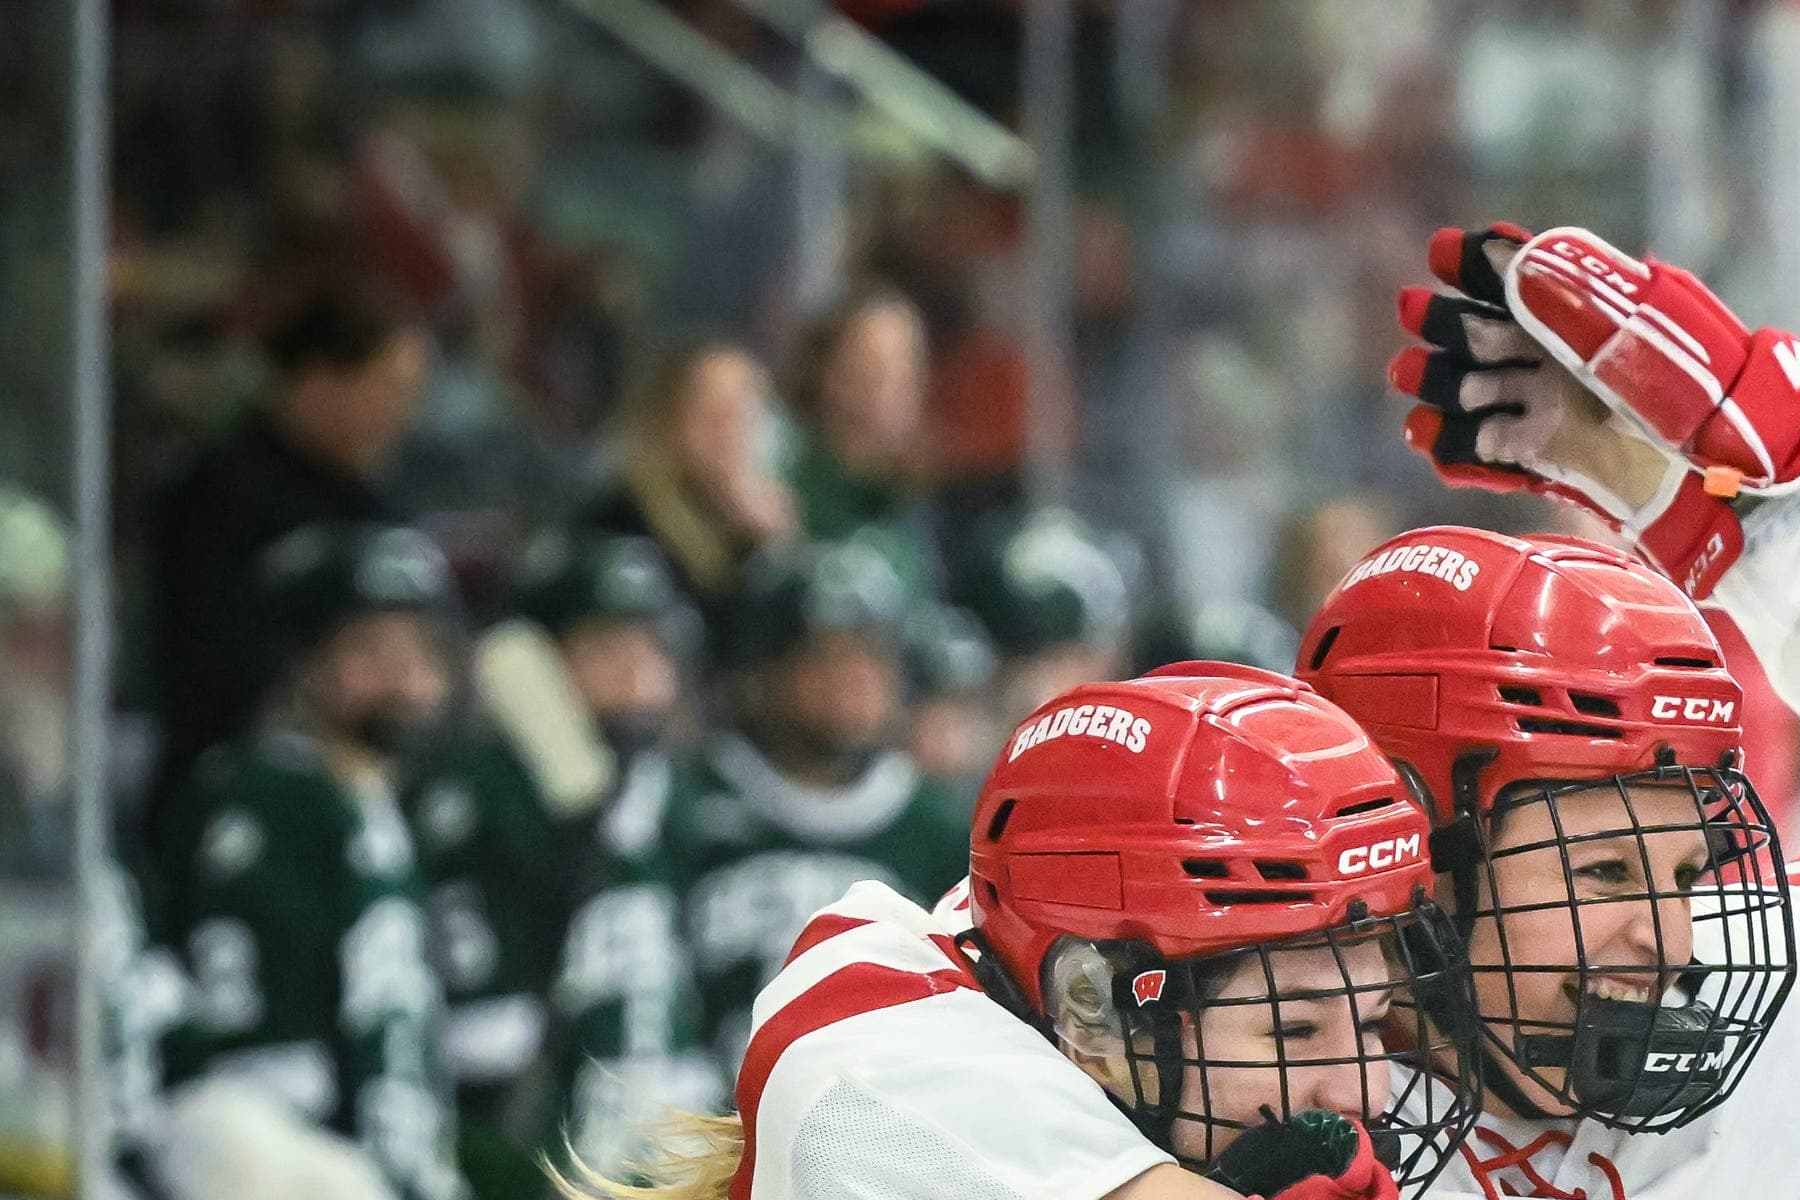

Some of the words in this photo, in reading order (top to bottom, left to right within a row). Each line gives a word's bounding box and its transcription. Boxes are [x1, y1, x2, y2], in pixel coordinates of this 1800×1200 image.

[1552, 241, 1638, 294] CCM
[1342, 545, 1480, 591] BADGERS
[1651, 695, 1735, 723] CCM
[1008, 705, 1152, 763] BADGERS
[1338, 833, 1420, 875] CCM
